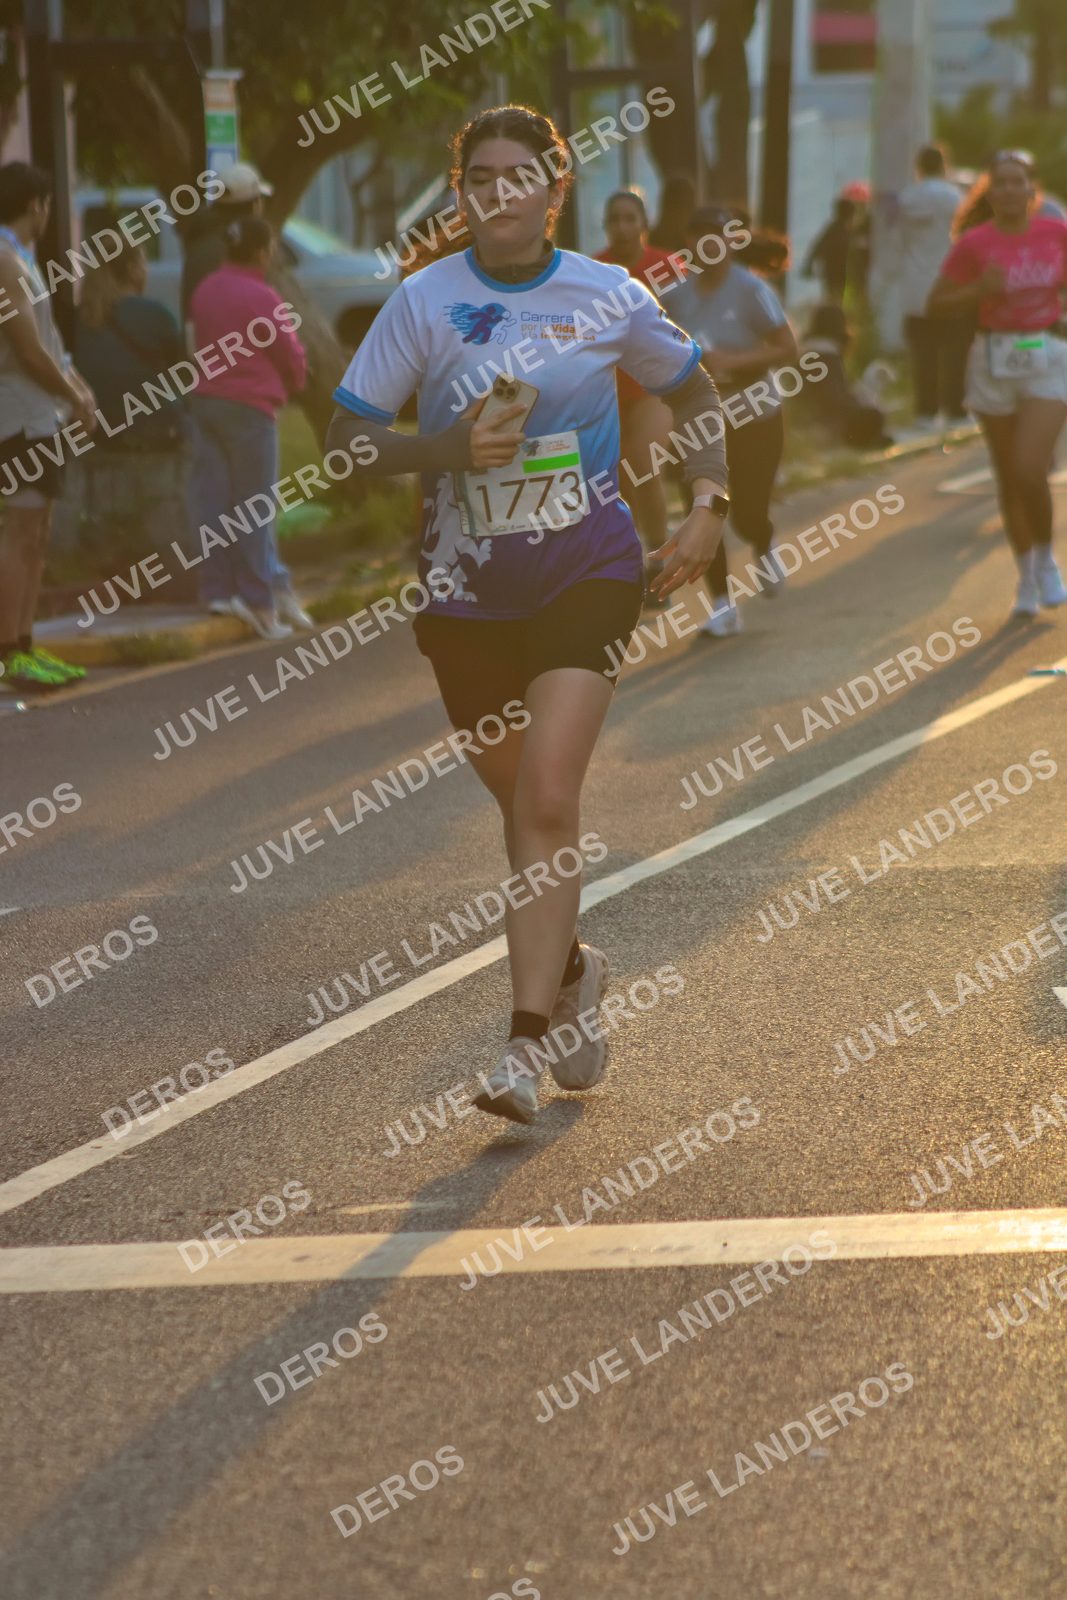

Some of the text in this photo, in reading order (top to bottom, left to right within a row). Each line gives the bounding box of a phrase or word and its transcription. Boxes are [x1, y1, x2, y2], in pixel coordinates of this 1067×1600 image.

[521, 311, 574, 323] Carrera
[521, 323, 536, 333] por
[552, 323, 576, 334] Vida
[476, 471, 583, 522] 1773
